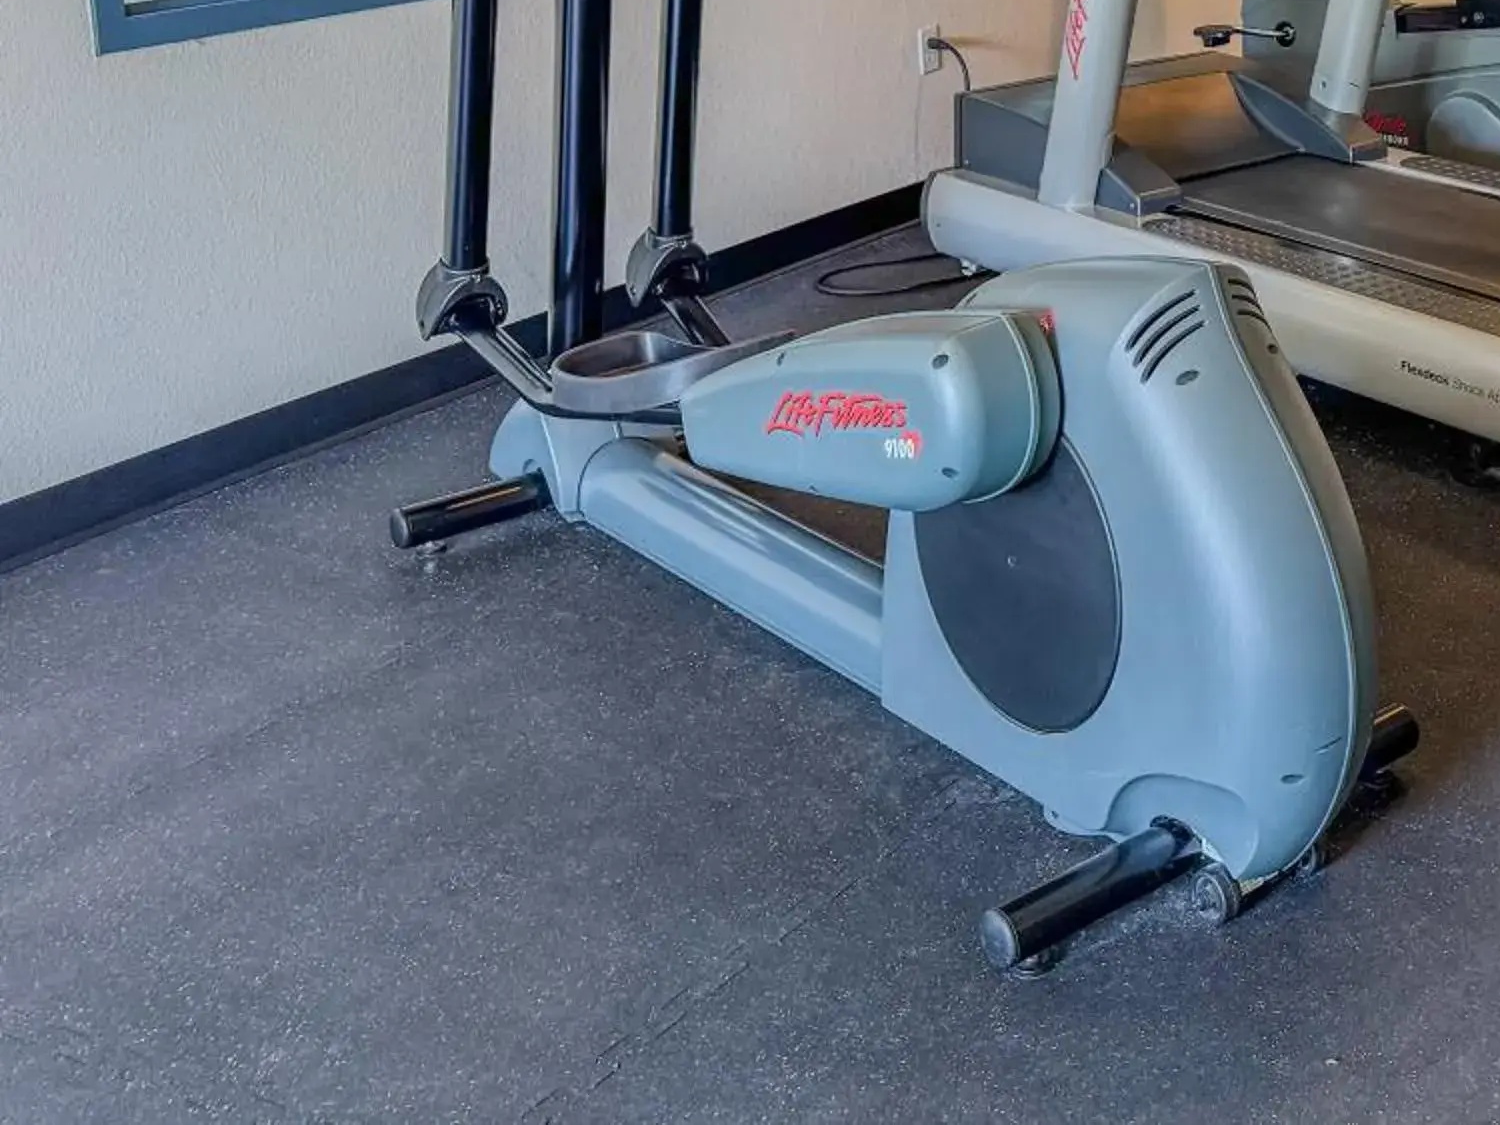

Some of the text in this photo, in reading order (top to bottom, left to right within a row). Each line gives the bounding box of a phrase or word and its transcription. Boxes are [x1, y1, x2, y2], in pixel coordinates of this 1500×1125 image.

[1401, 361, 1449, 386] Flexdeck
[767, 391, 907, 437] Life Fitness
[884, 437, 915, 459] 9100
